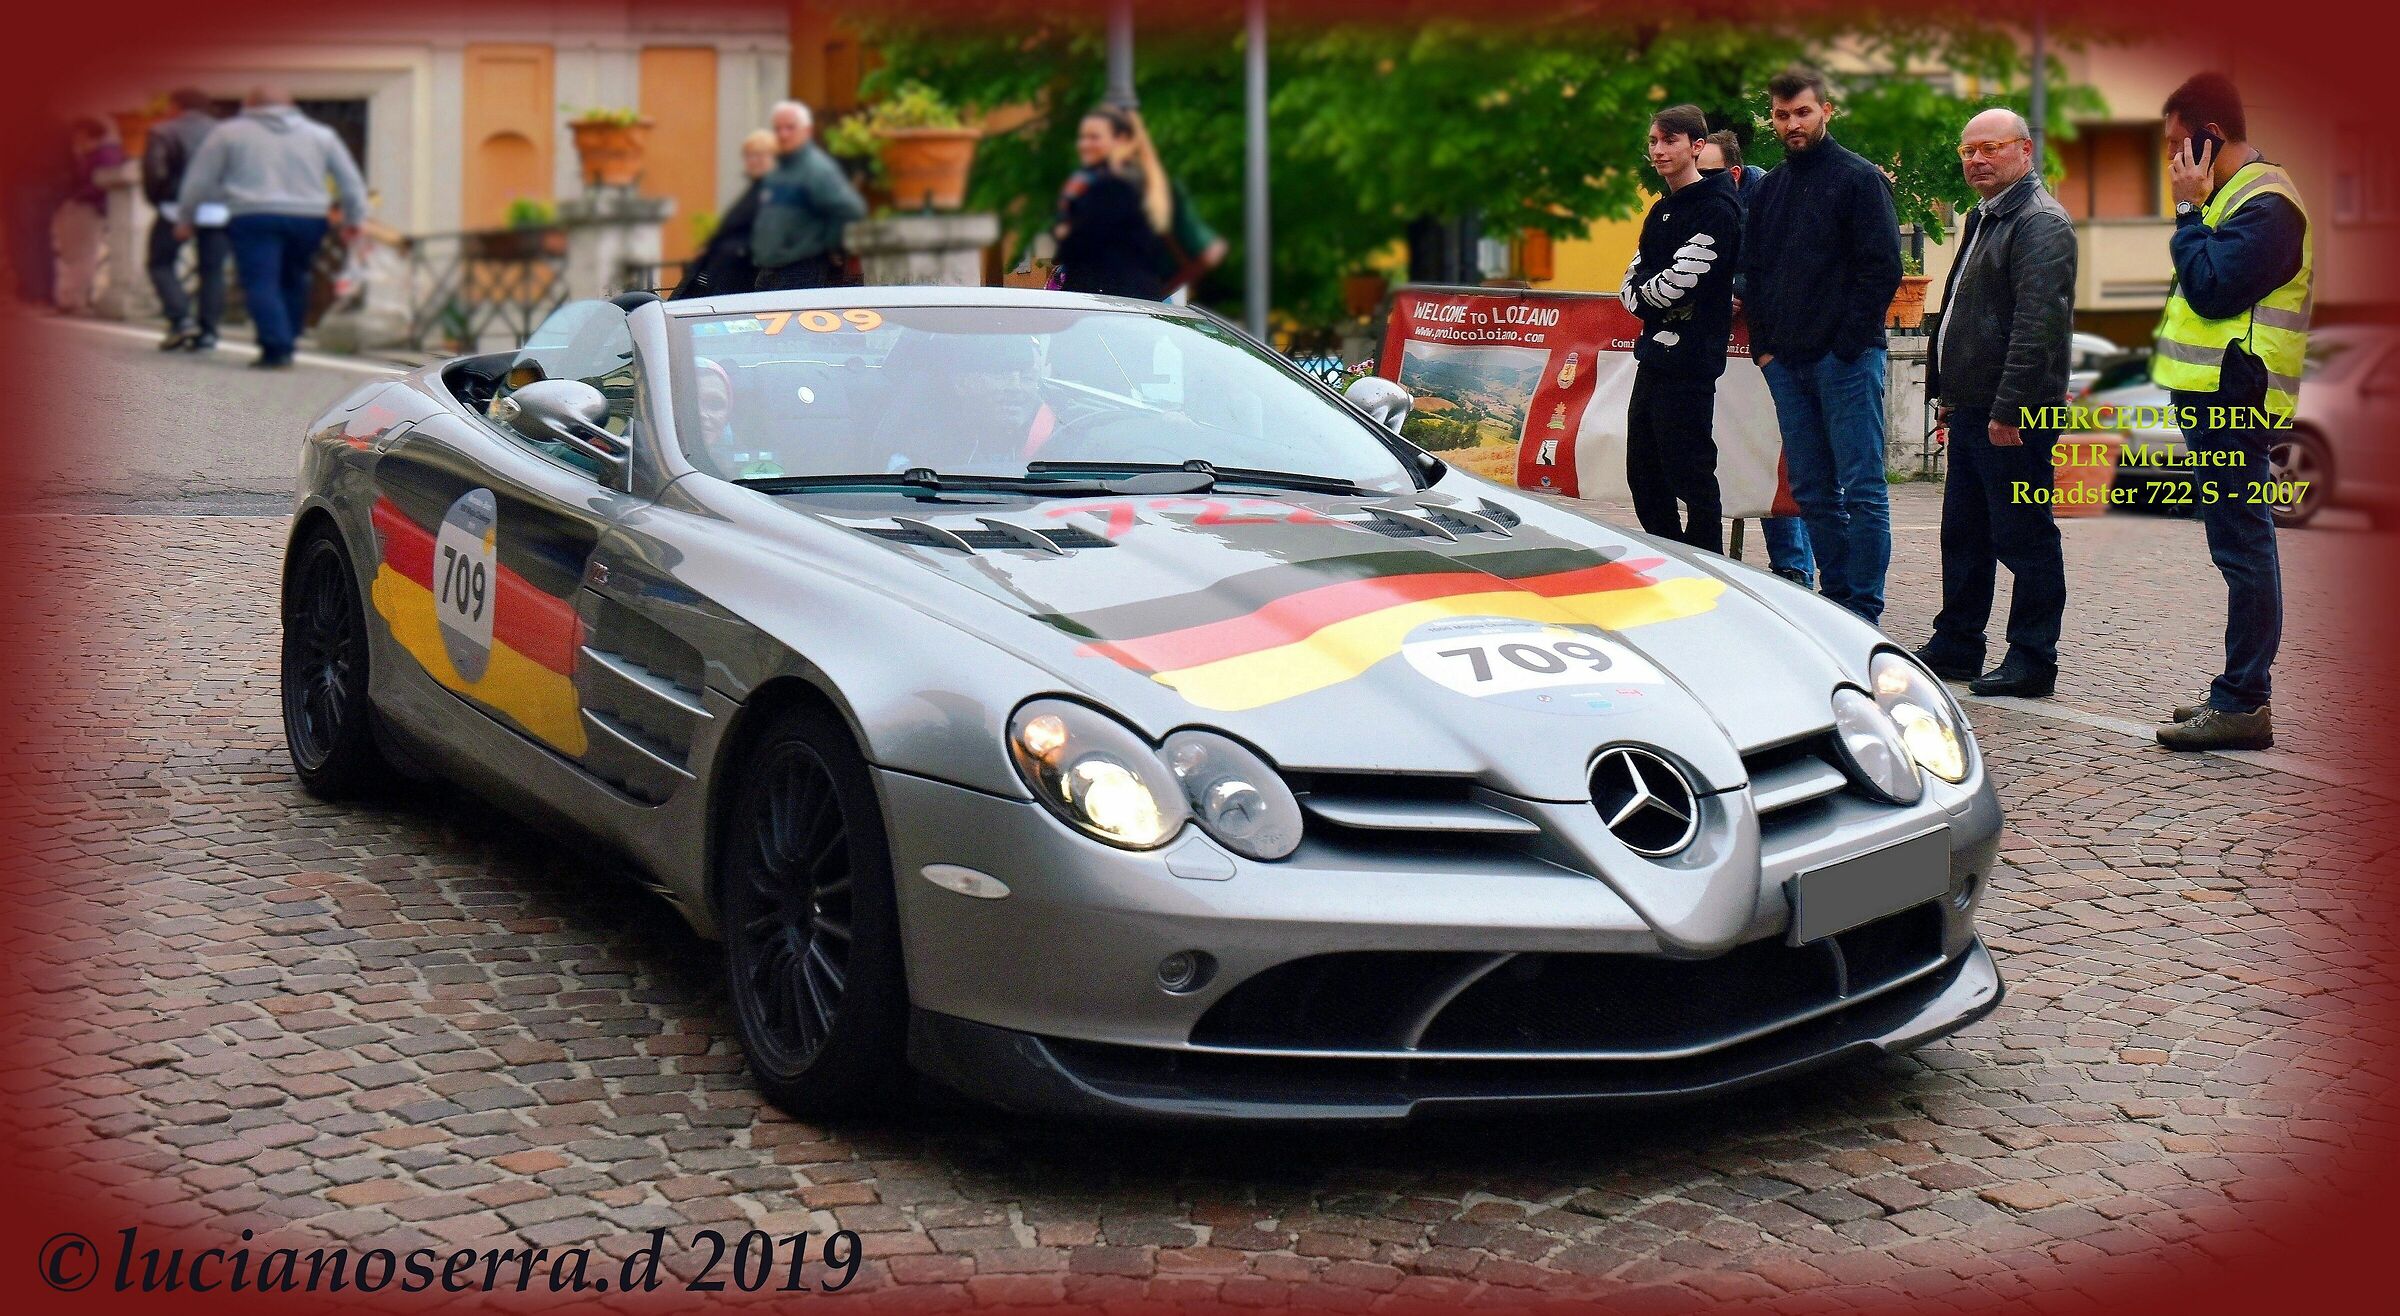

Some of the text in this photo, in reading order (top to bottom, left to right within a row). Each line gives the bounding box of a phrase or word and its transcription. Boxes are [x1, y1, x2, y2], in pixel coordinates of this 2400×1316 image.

[755, 308, 882, 336] 709
[1413, 301, 1468, 323] WELCOME
[1492, 305, 1560, 327] LOIANO
[1414, 326, 1545, 343] www.prolocoloiano.com
[1611, 338, 1635, 348] Comi
[442, 545, 486, 622] 709
[1437, 641, 1613, 682] 709
